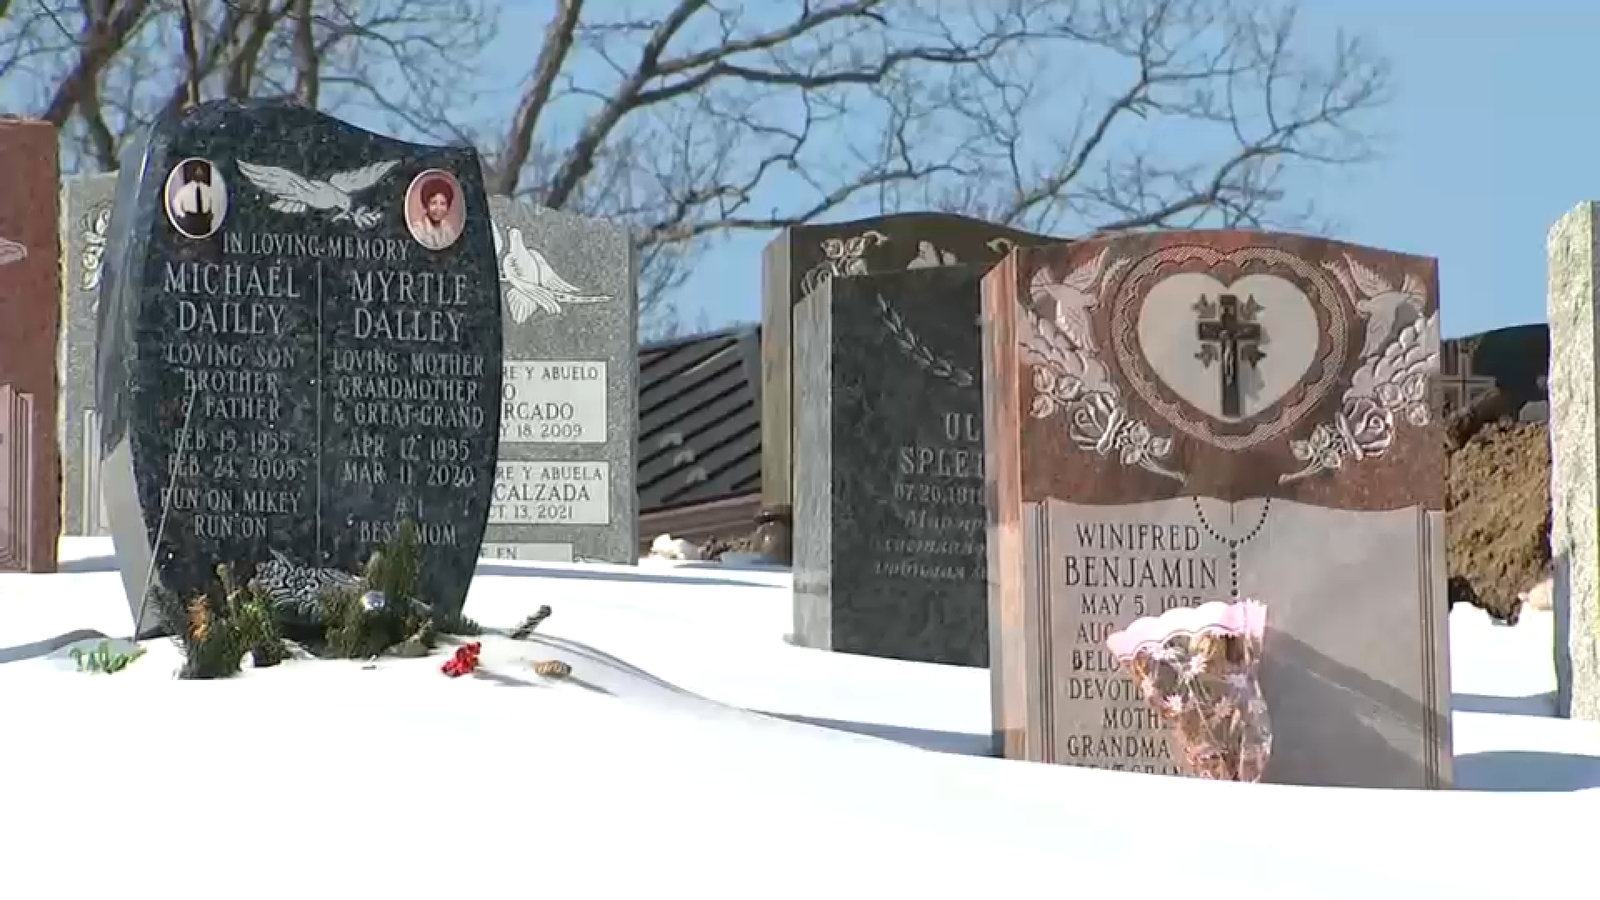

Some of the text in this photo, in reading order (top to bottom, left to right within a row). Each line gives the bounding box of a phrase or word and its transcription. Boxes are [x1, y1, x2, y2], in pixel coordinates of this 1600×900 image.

[223, 233, 411, 261] IN LOVING MEMORY
[163, 262, 300, 298] MICHAEL
[351, 272, 468, 305] MYRTLE
[179, 301, 287, 334] DAILEY
[355, 307, 464, 342] DALLEY
[167, 344, 295, 369] LOVING SON
[333, 349, 484, 376] LOVING MOTHER
[184, 369, 279, 394] BROTHER
[525, 366, 535, 380] Y
[541, 366, 599, 380] ABUELO
[339, 376, 478, 402] GRANDMOTHER
[205, 399, 280, 421] FATHER
[333, 402, 344, 423] &
[503, 402, 574, 420] RCADO
[541, 424, 582, 438] 2009
[945, 412, 980, 441] UL
[250, 431, 290, 453] 1955
[427, 464, 476, 488] 2020
[523, 467, 532, 480] Y
[542, 467, 602, 481] ABUELA
[160, 486, 301, 513] RUN ON MIKEY
[495, 484, 590, 501] CALZADA
[538, 505, 572, 519] 2021
[194, 514, 268, 538] RUN ON
[360, 521, 456, 546] BEST MOM
[1076, 523, 1199, 551] WINIFRED
[1065, 556, 1217, 589] BENJAMIN
[1081, 594, 1124, 616] MAY
[1103, 707, 1168, 730] MOTH
[1067, 734, 1171, 758] GRANDMA
